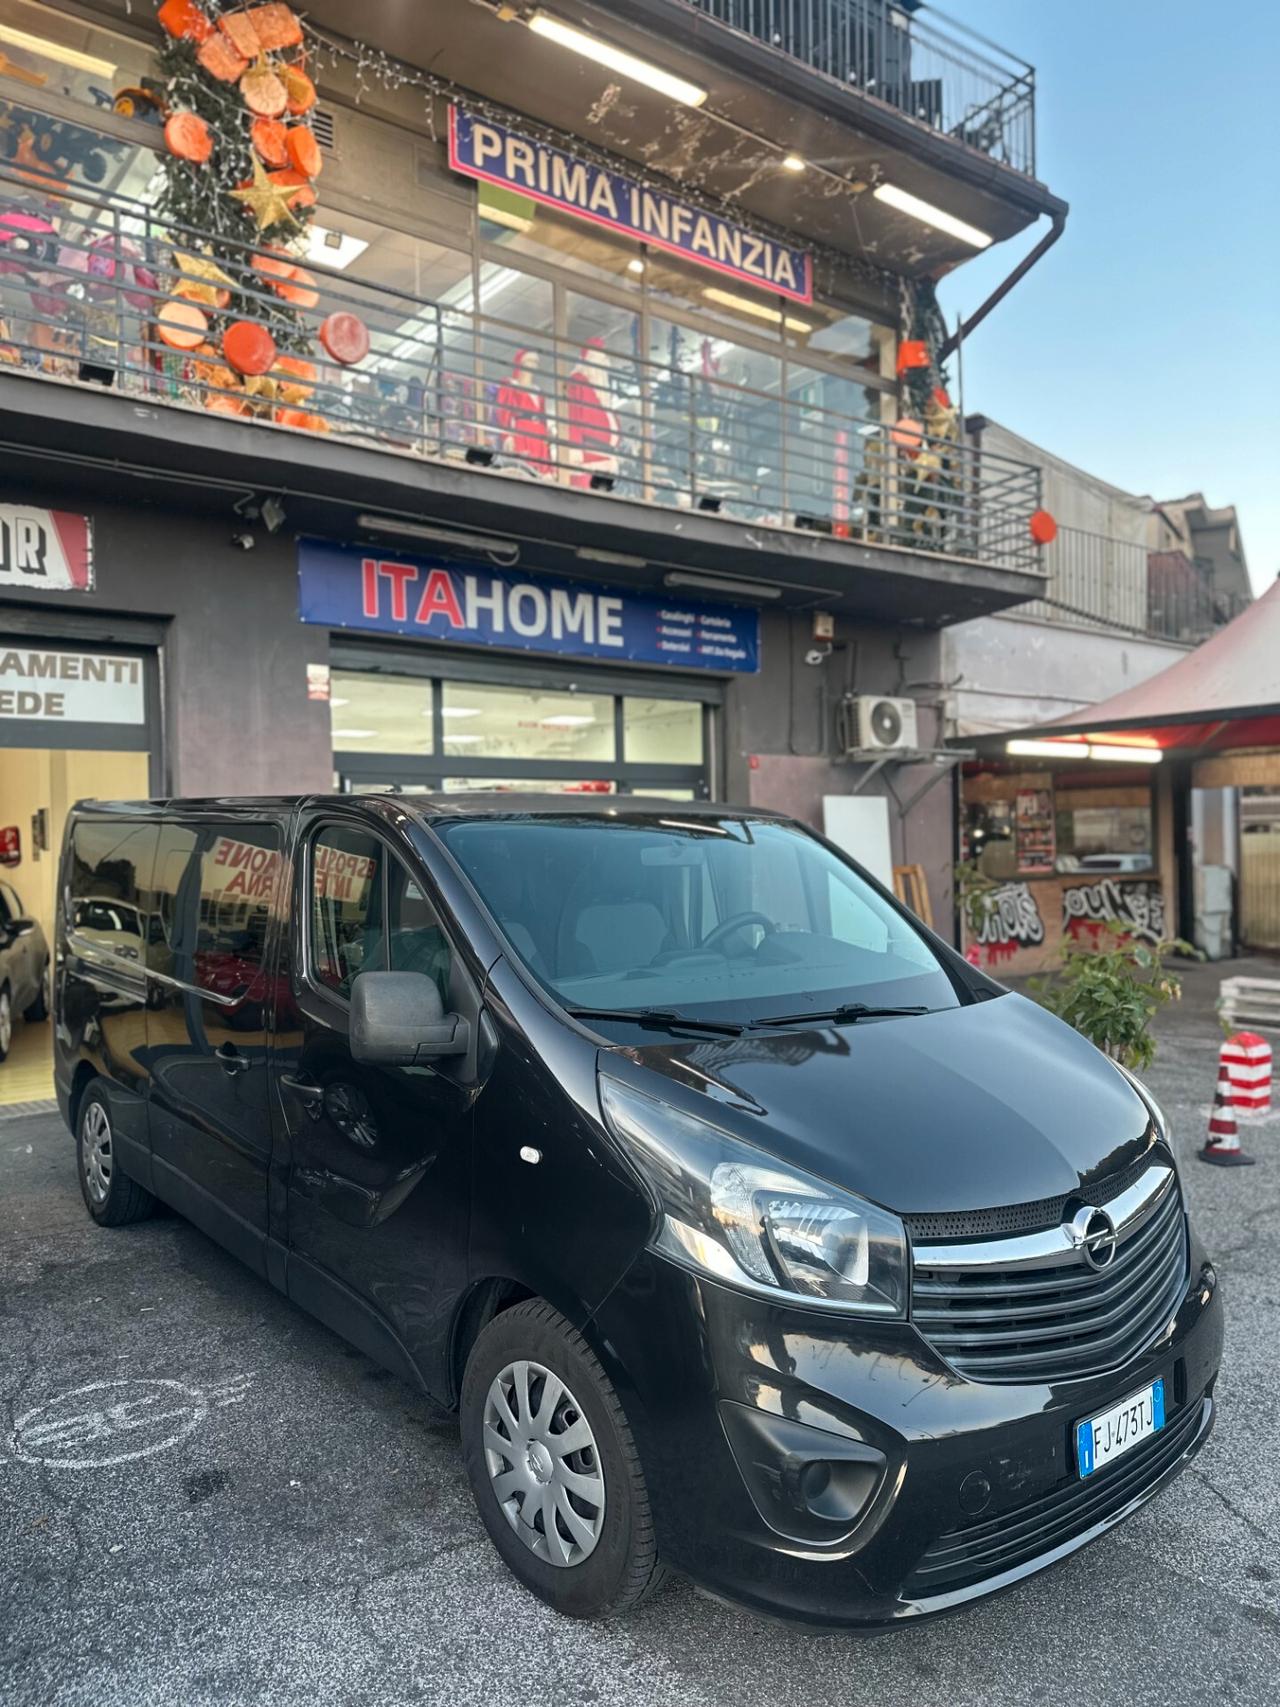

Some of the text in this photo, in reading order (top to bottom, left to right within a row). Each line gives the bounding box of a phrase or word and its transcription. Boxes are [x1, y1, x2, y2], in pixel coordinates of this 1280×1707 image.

[472, 123, 796, 289] PRIMA INFANZIA
[362, 558, 624, 647] ITAHOME
[0, 689, 65, 716] EDE
